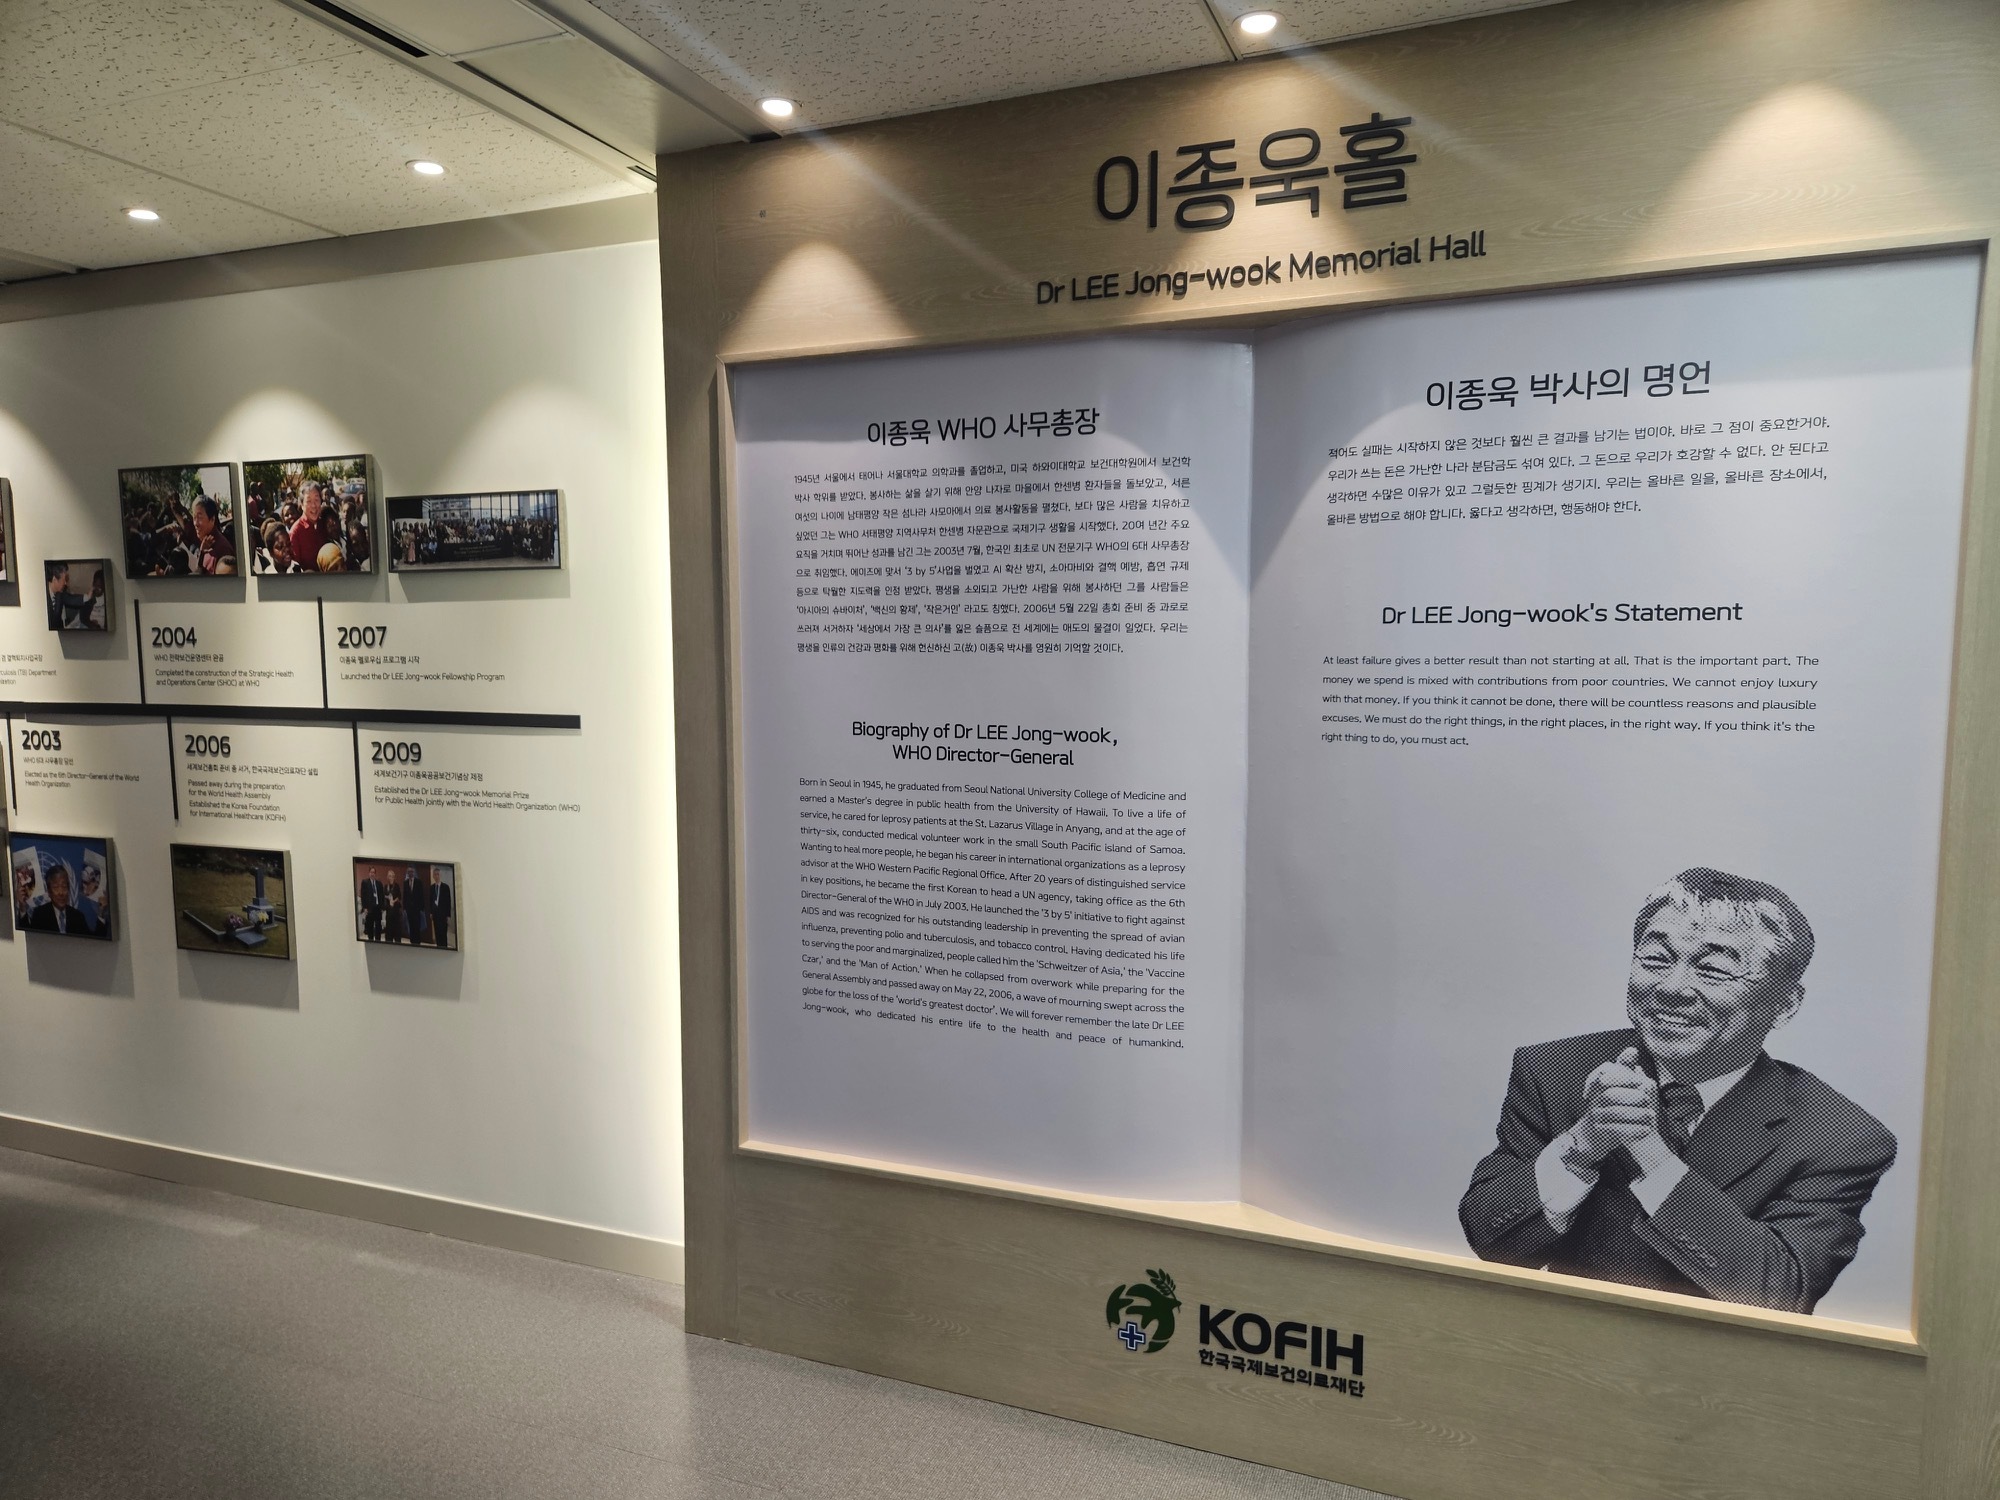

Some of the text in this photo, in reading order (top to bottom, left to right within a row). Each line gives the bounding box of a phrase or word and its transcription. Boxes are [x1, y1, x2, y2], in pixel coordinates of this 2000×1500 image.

[1097, 112, 1417, 229] 이종욱홀
[1037, 230, 1487, 304] Dr LEE Jong-wook Memorial Hall
[1427, 361, 1710, 412] 이종욱 박사의 명언
[868, 407, 1100, 448] 이종욱 WHO 사무총장
[1327, 500, 1641, 526] 올바른 방법으로 해야 합니다. 옳다고 생각하면, 행동해야 한다.
[1383, 603, 1743, 627] Dr LEE Jong-wook's Statement
[152, 627, 197, 648] 2004
[337, 626, 387, 648] 2007
[798, 642, 1124, 654] 평생을 인류의 건강과 평화를 위해 헌신하신 고(故) 이종욱 박사를 영원히 기억할 것이다.
[155, 668, 184, 677] Completed
[231, 669, 237, 677] of
[249, 670, 274, 679] Strategic
[167, 678, 196, 687] Operations
[217, 679, 238, 687] (SHOC)
[245, 679, 260, 687] WHO
[371, 672, 382, 680] the
[382, 672, 390, 680] Dr
[391, 672, 404, 680] LEE
[405, 672, 441, 682] Jong-wook
[442, 672, 476, 681] Fellowship
[476, 673, 505, 682] Program
[21, 730, 61, 750] 2003
[853, 721, 1117, 747] Biography of Dr LEE Jong-wook,
[1322, 732, 1469, 746] right thing to do, you must act.
[185, 735, 231, 756] 2006
[371, 742, 422, 763] 2009
[892, 744, 1074, 766] WHO Director-General
[188, 779, 208, 787] Passed
[209, 781, 223, 789] away
[224, 781, 242, 790] during
[253, 783, 286, 792] preparation
[188, 788, 197, 796] for
[225, 790, 243, 798] Health
[244, 791, 271, 801] Assembly
[374, 785, 530, 799] Established the Dr LEE Jong-wook Memorial Prize
[189, 800, 220, 809] Established
[231, 802, 248, 810] Korea
[249, 803, 280, 812] Foundation
[385, 796, 404, 804] Public
[404, 797, 425, 805] Health
[426, 798, 445, 808] jointly
[446, 799, 460, 807] with
[460, 799, 472, 807] the
[472, 800, 492, 808] World
[493, 801, 514, 809] Health
[516, 802, 557, 812] Organization
[558, 804, 581, 812] (WHO)
[190, 809, 286, 822] for International Healthcare (KOFIH)
[803, 1002, 1184, 1051] Jong-wook, who dedicated his entire life to the health and peace of humankind.
[1200, 1304, 1364, 1376] KOFIH
[1199, 1348, 1366, 1398] 한국국제보건의료재단
